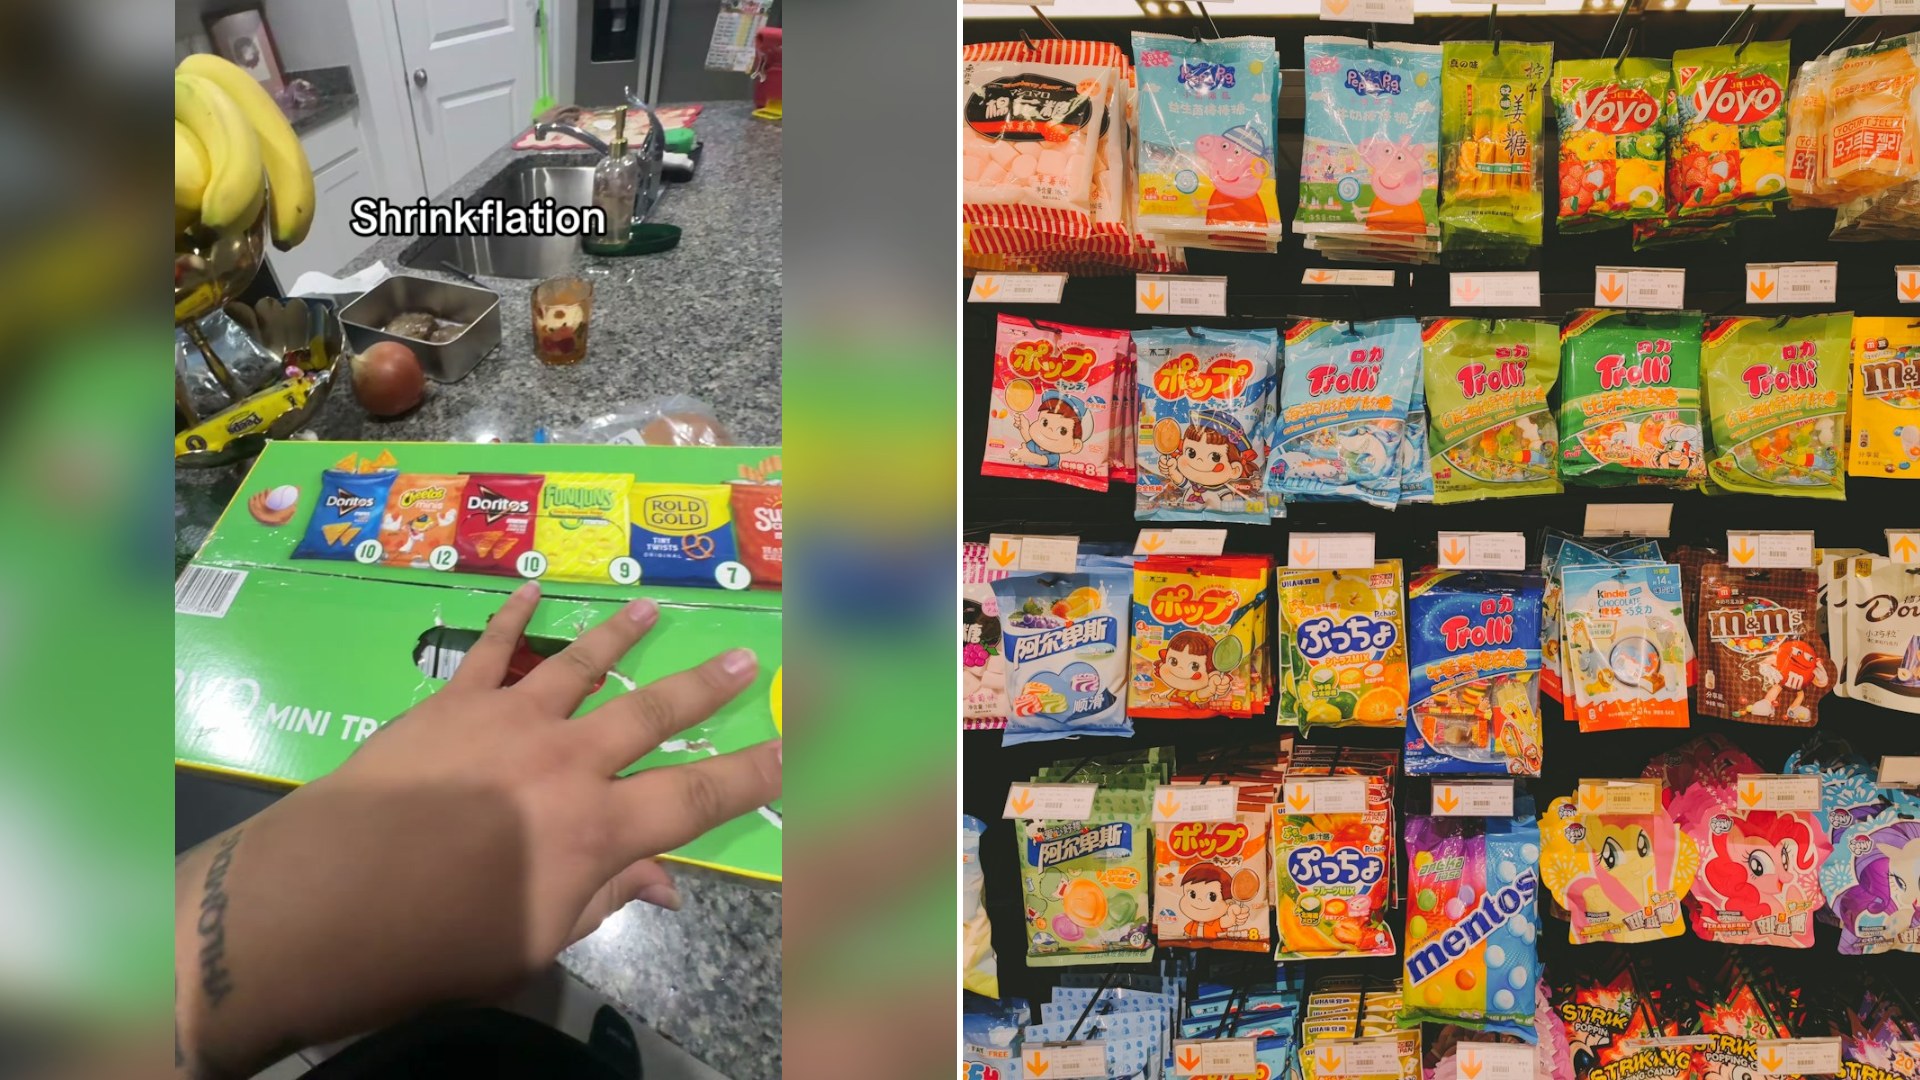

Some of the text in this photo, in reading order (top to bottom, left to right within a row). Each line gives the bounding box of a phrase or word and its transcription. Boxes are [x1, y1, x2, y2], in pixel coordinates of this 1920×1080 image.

[1730, 77, 1766, 89] JELLY
[1610, 90, 1645, 100] JELLY
[1692, 77, 1777, 124] Yoyo
[1572, 89, 1653, 132] Yoyo
[1013, 344, 1094, 379] ポップ
[1157, 357, 1249, 398] ポップ
[1306, 363, 1381, 397] Trolli
[1456, 360, 1526, 399] Trolli
[1594, 354, 1672, 391] Trolli
[1741, 359, 1817, 399] Trolli
[1085, 463, 1097, 477] 8
[326, 494, 374, 508] Doritos
[400, 486, 447, 508] Cheetos
[467, 495, 529, 513] Doritos
[651, 499, 700, 513] ROLD
[651, 511, 702, 526] GOLD
[646, 543, 679, 552] TWISTS
[652, 536, 671, 544] TINY
[361, 543, 377, 559] 10
[436, 549, 452, 567] 12
[522, 556, 540, 573] 10
[619, 561, 630, 579] 9
[726, 566, 737, 585] 7
[1369, 578, 1393, 587] JAPAN
[1155, 588, 1238, 623] ポップ
[1598, 597, 1642, 608] CHOCOLATE
[1300, 616, 1392, 654] ぷっちょ
[1441, 615, 1513, 652] Trolli
[1013, 617, 1109, 672] 阿尔卑斯
[1231, 700, 1242, 711] 8
[262, 702, 388, 742] MINI TR
[1173, 823, 1246, 857] ポップ
[1037, 824, 1123, 875] 阿尔卑斯
[1291, 850, 1380, 882] ぷっちょ
[1418, 856, 1464, 876] aneka
[1249, 929, 1259, 940] 8
[1407, 869, 1538, 985] mentos
[1132, 933, 1143, 942] 20
[1562, 1003, 1630, 1030] STRIK
[1751, 1020, 1768, 1036] 20
[988, 1050, 1009, 1058] FREE
[1705, 1052, 1750, 1068] POPPING
[1895, 1052, 1915, 1069] 20
[1590, 1049, 1691, 1080] STRIKING
[1648, 1067, 1680, 1079] CANDY
